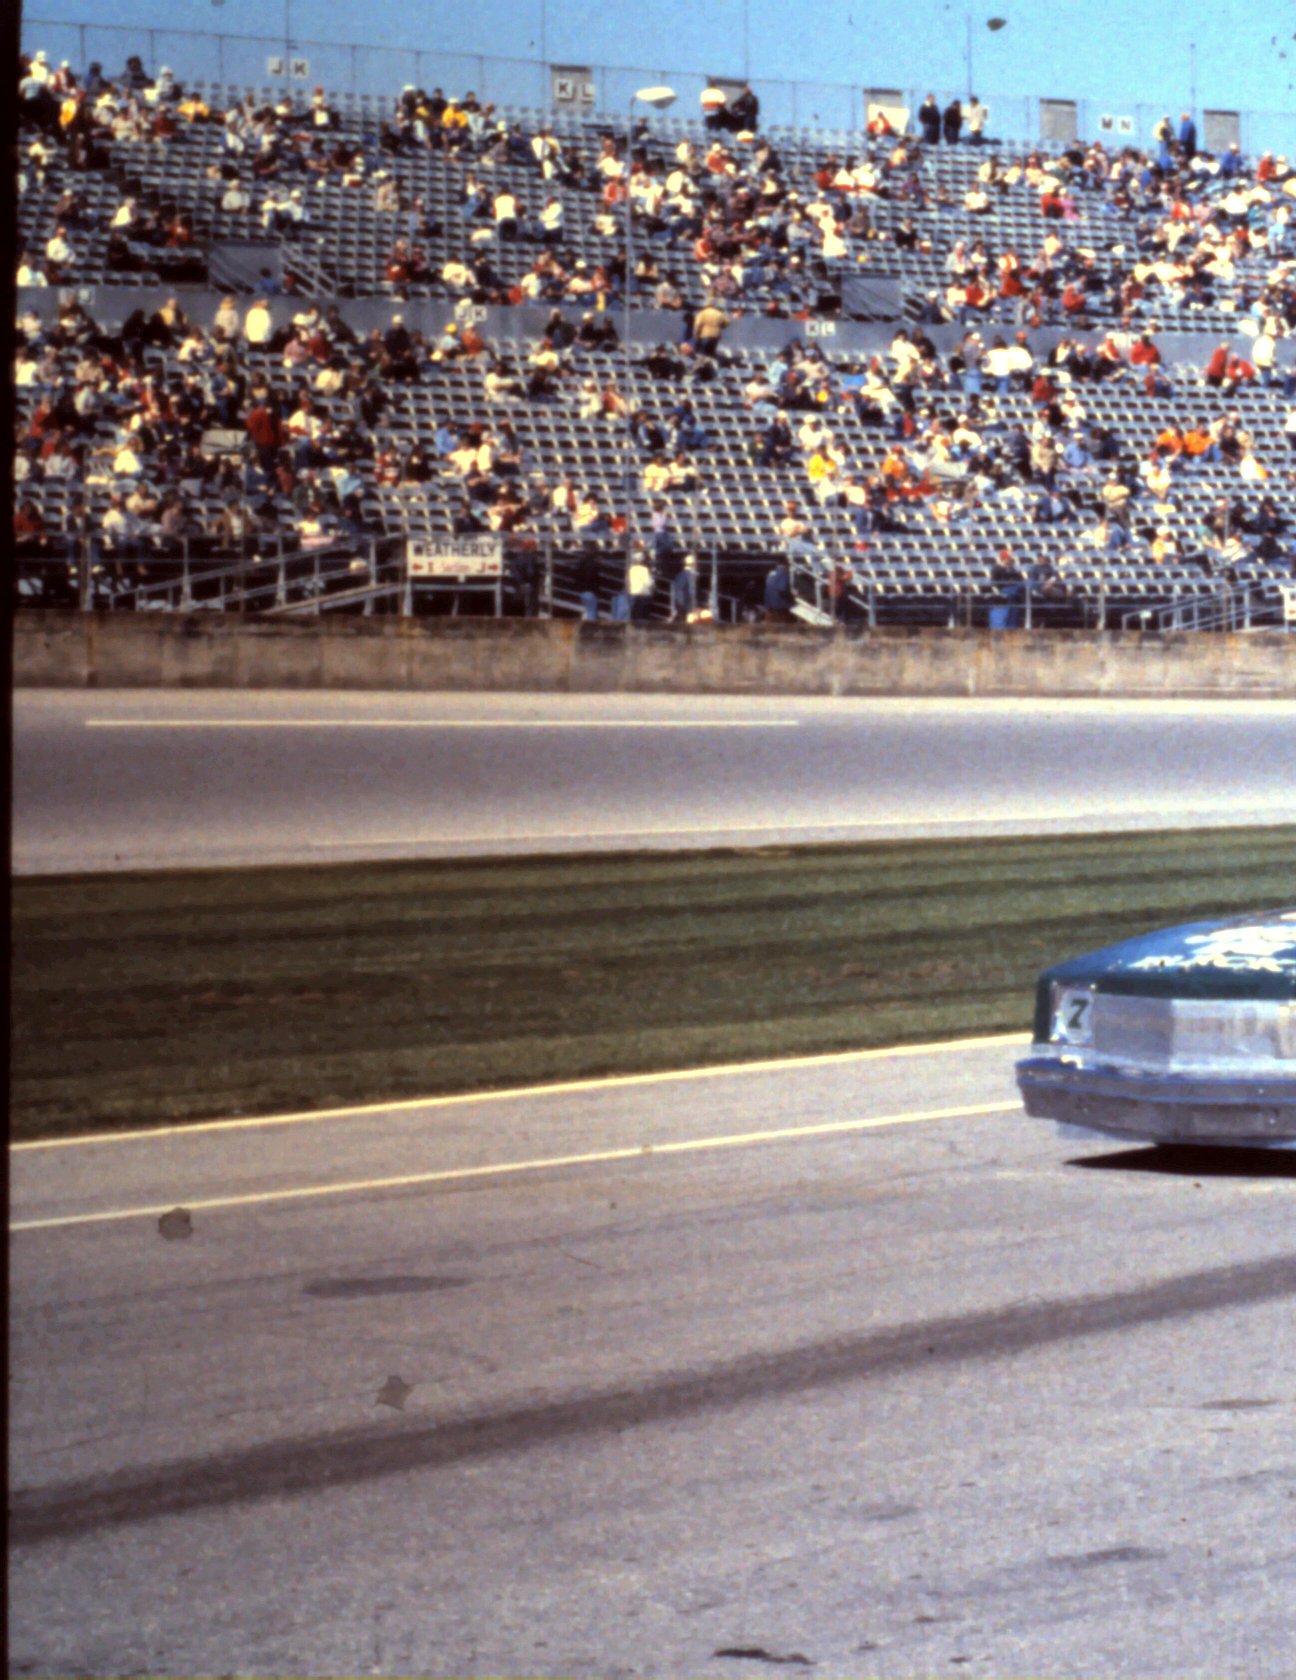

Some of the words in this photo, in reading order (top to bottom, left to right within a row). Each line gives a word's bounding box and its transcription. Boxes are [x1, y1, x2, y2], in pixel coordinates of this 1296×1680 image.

[271, 59, 283, 76] J
[294, 61, 306, 75] K
[558, 81, 571, 97] K
[1120, 119, 1131, 131] N
[1068, 998, 1089, 1030] 7
